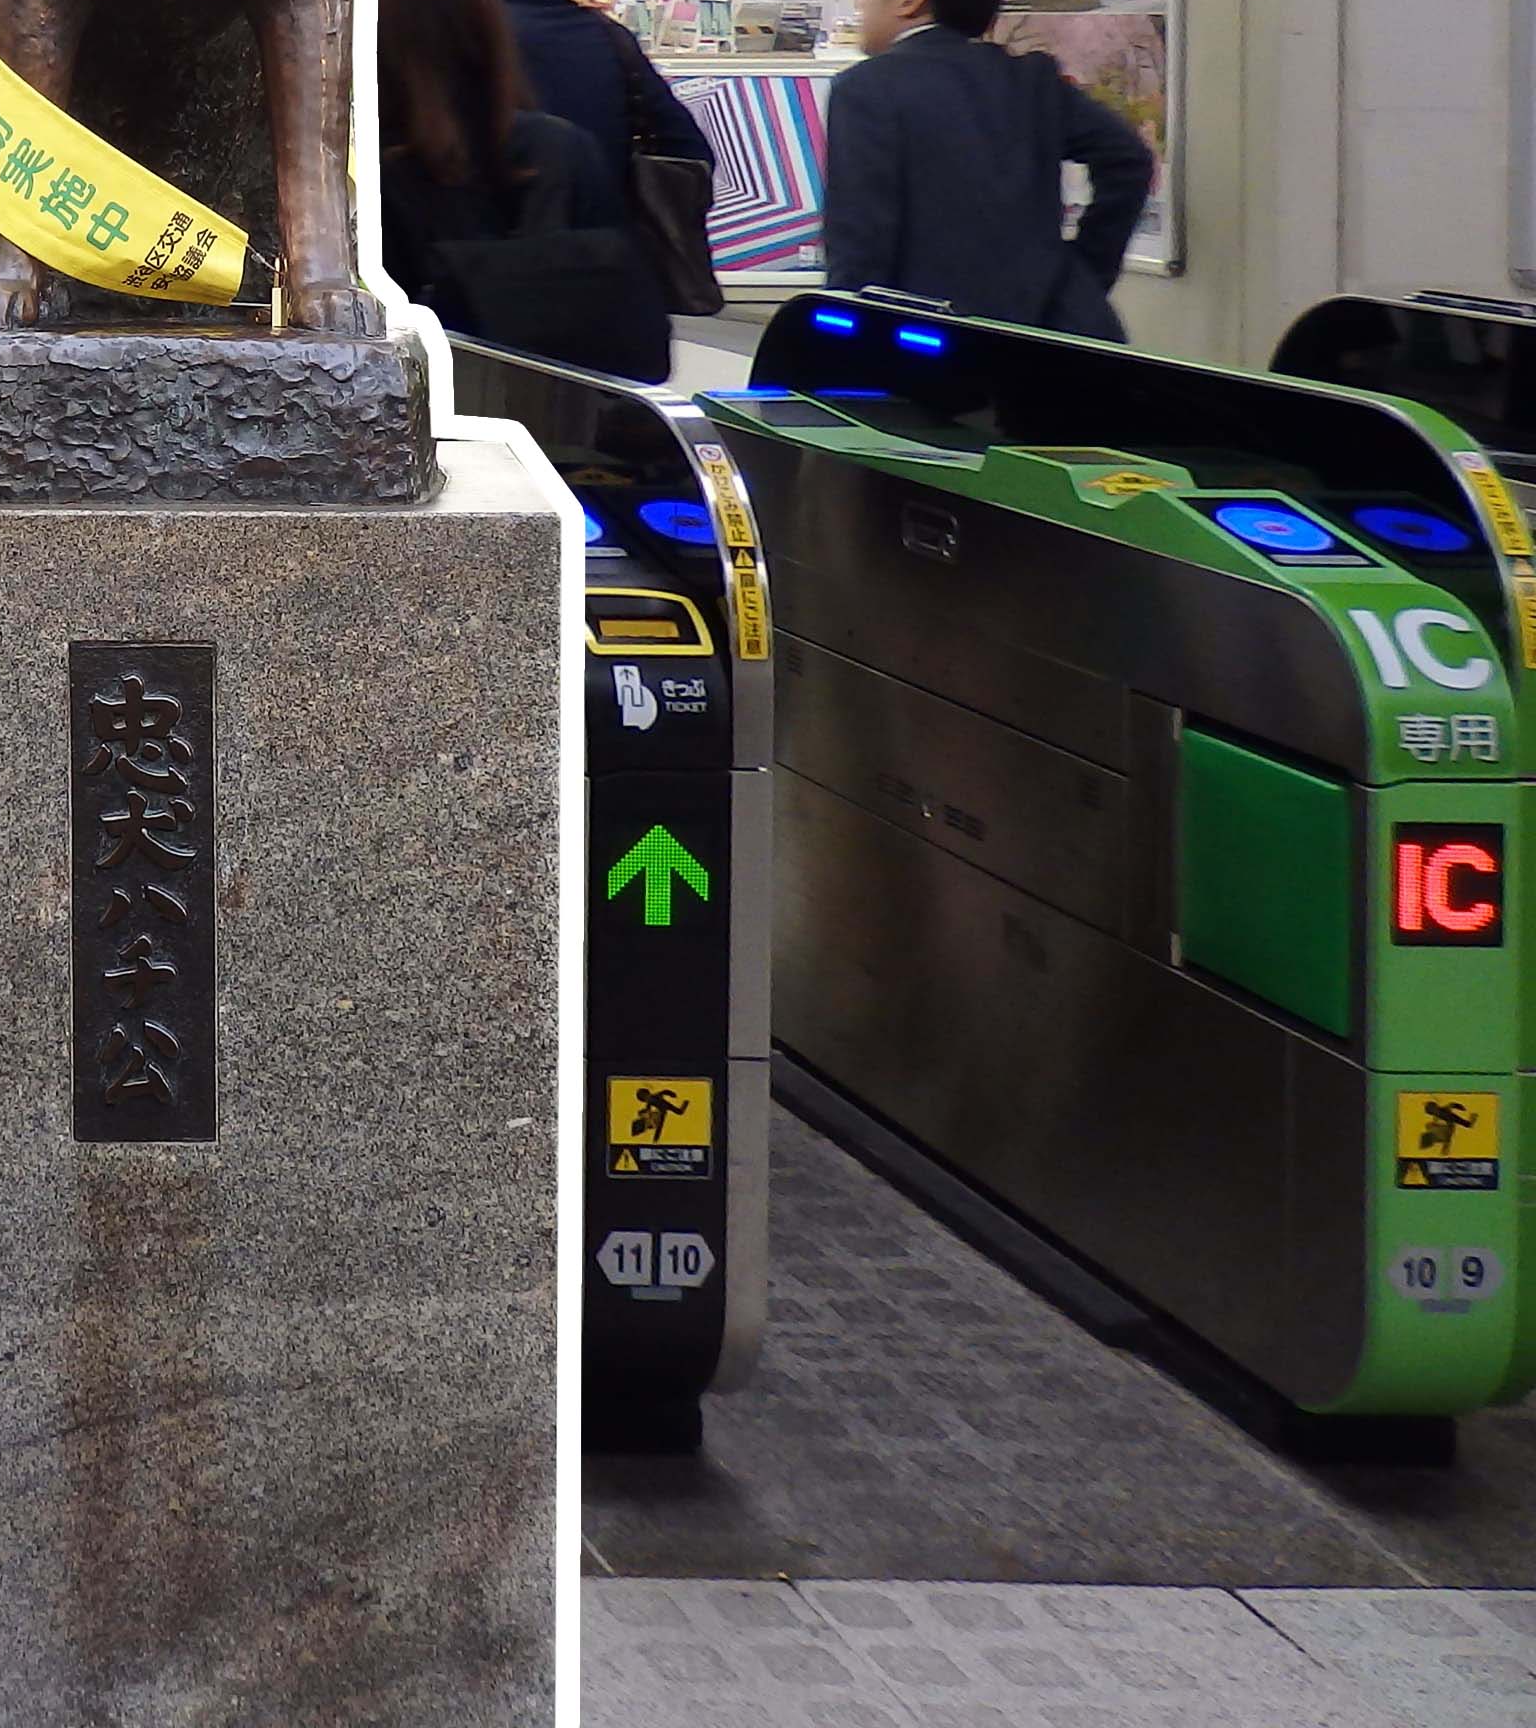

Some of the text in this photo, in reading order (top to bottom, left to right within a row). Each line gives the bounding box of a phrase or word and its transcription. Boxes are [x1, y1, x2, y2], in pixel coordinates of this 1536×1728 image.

[1348, 609, 1491, 689] IC
[1396, 713, 1500, 762] 専用
[82, 673, 196, 1105] 忠犬ハチ公
[1398, 844, 1496, 931] IC
[613, 1245, 643, 1271] 11
[668, 1245, 700, 1273] 10
[1403, 1256, 1437, 1288] 10
[1462, 1256, 1484, 1287] 9
